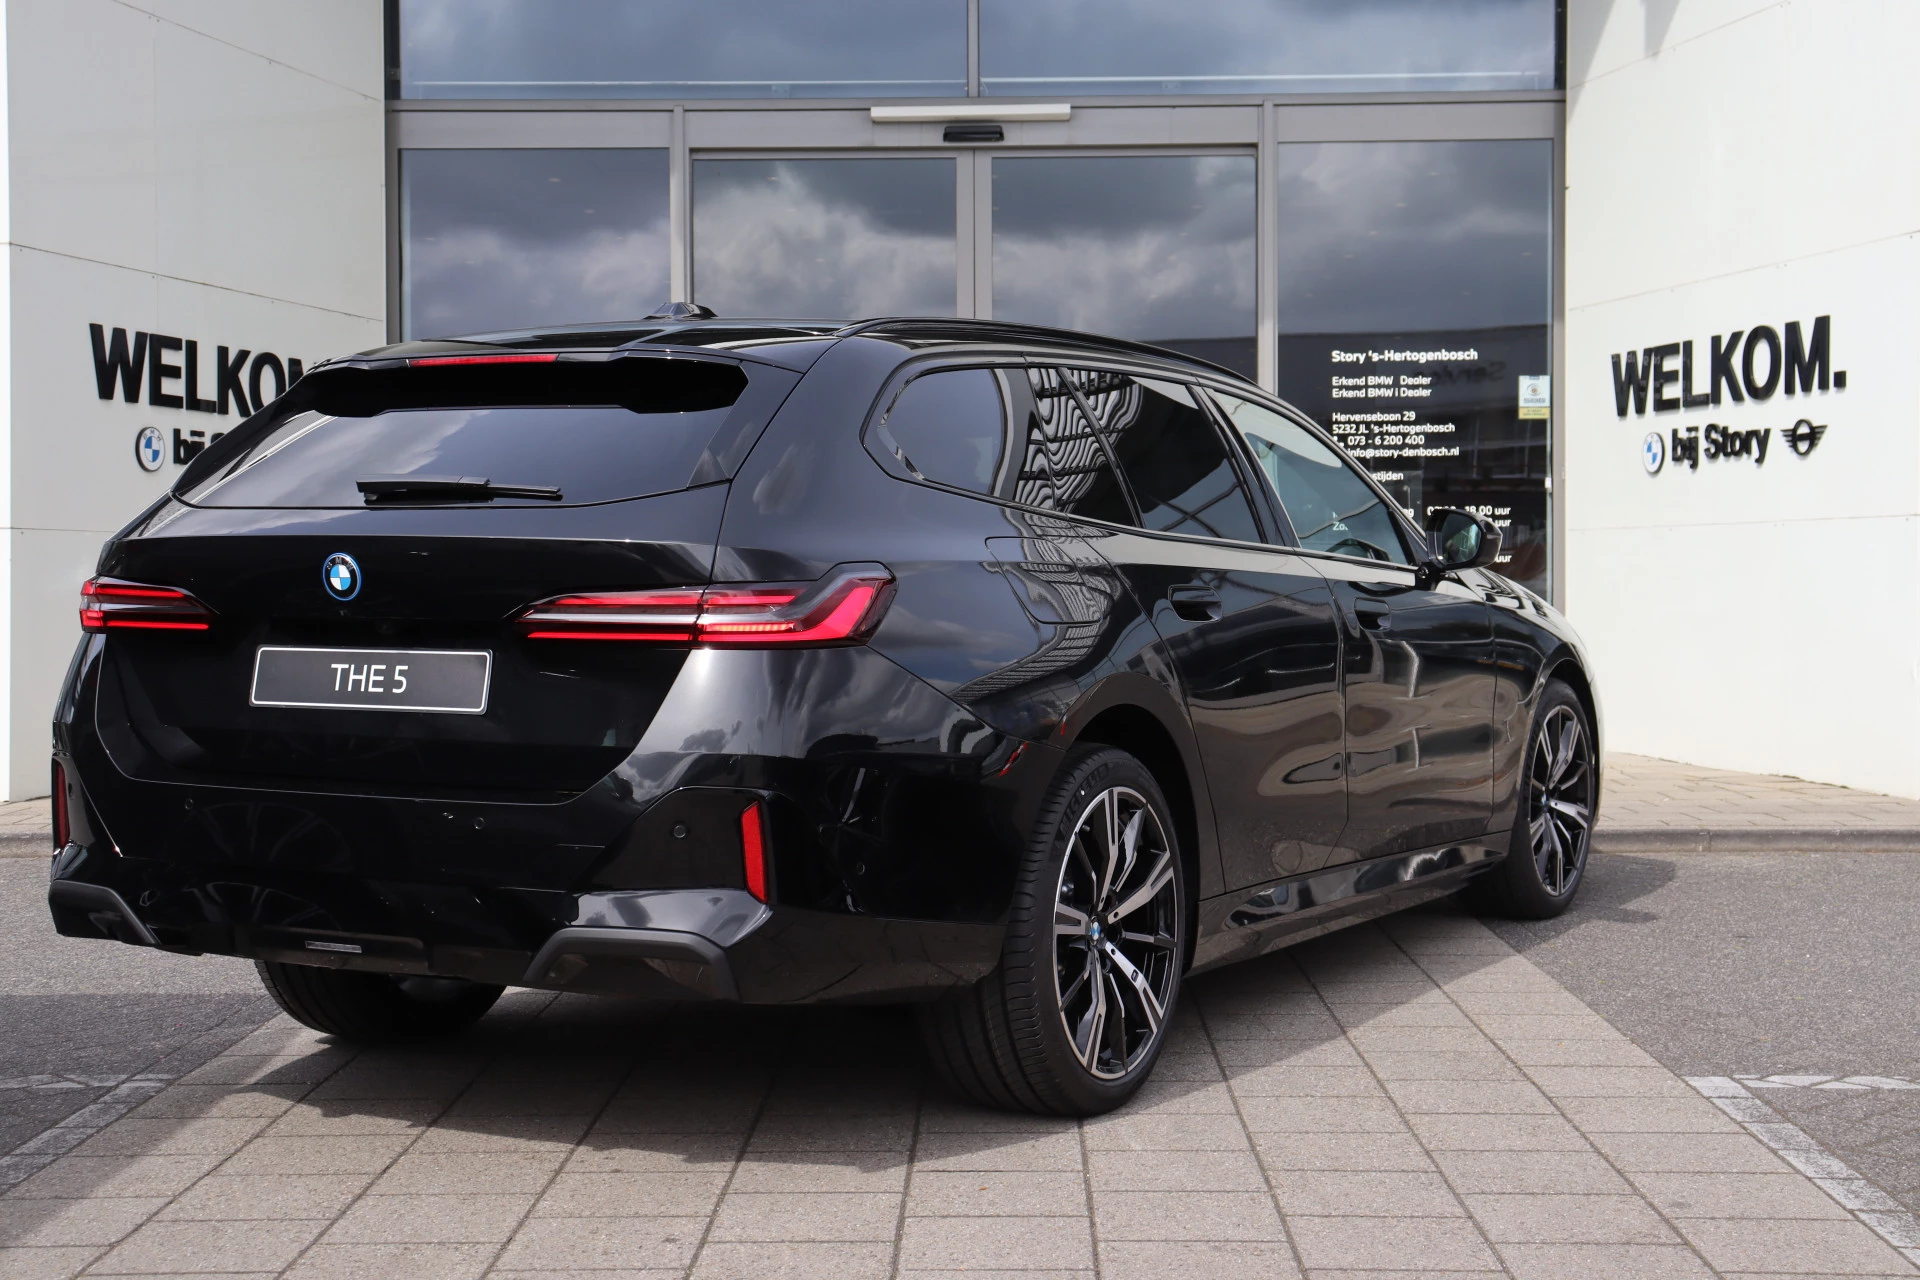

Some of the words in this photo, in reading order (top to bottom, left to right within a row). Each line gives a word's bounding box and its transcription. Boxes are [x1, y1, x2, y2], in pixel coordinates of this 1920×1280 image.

[1331, 351, 1366, 364] Story
[1368, 348, 1479, 363] 's-Hertogenbosch
[89, 323, 304, 418] WELKO
[1611, 314, 1847, 417] WELKOM.
[1332, 376, 1366, 386] Erkend
[1368, 376, 1394, 386] BMW
[1400, 375, 1432, 385] Dealer
[1332, 388, 1366, 398] Erkend
[1368, 388, 1394, 397] BMW
[1395, 388, 1399, 397] i
[1400, 387, 1432, 397] Dealer
[1332, 412, 1402, 422] Hervensebaan
[1402, 411, 1416, 421] 29
[1332, 424, 1357, 434] 5232
[1358, 424, 1370, 434] JL
[1371, 423, 1456, 435] 's-Hertogenbosch
[1347, 436, 1366, 446] 073
[1374, 435, 1382, 445] 6
[1383, 435, 1403, 445] 200
[1404, 435, 1425, 445] 400
[1703, 423, 1771, 464] Story
[1348, 446, 1460, 459] info@story-denbosch.nl
[1372, 471, 1404, 482] stijden
[1494, 506, 1512, 515] uur
[330, 663, 386, 693] THE
[392, 665, 409, 694] 5
